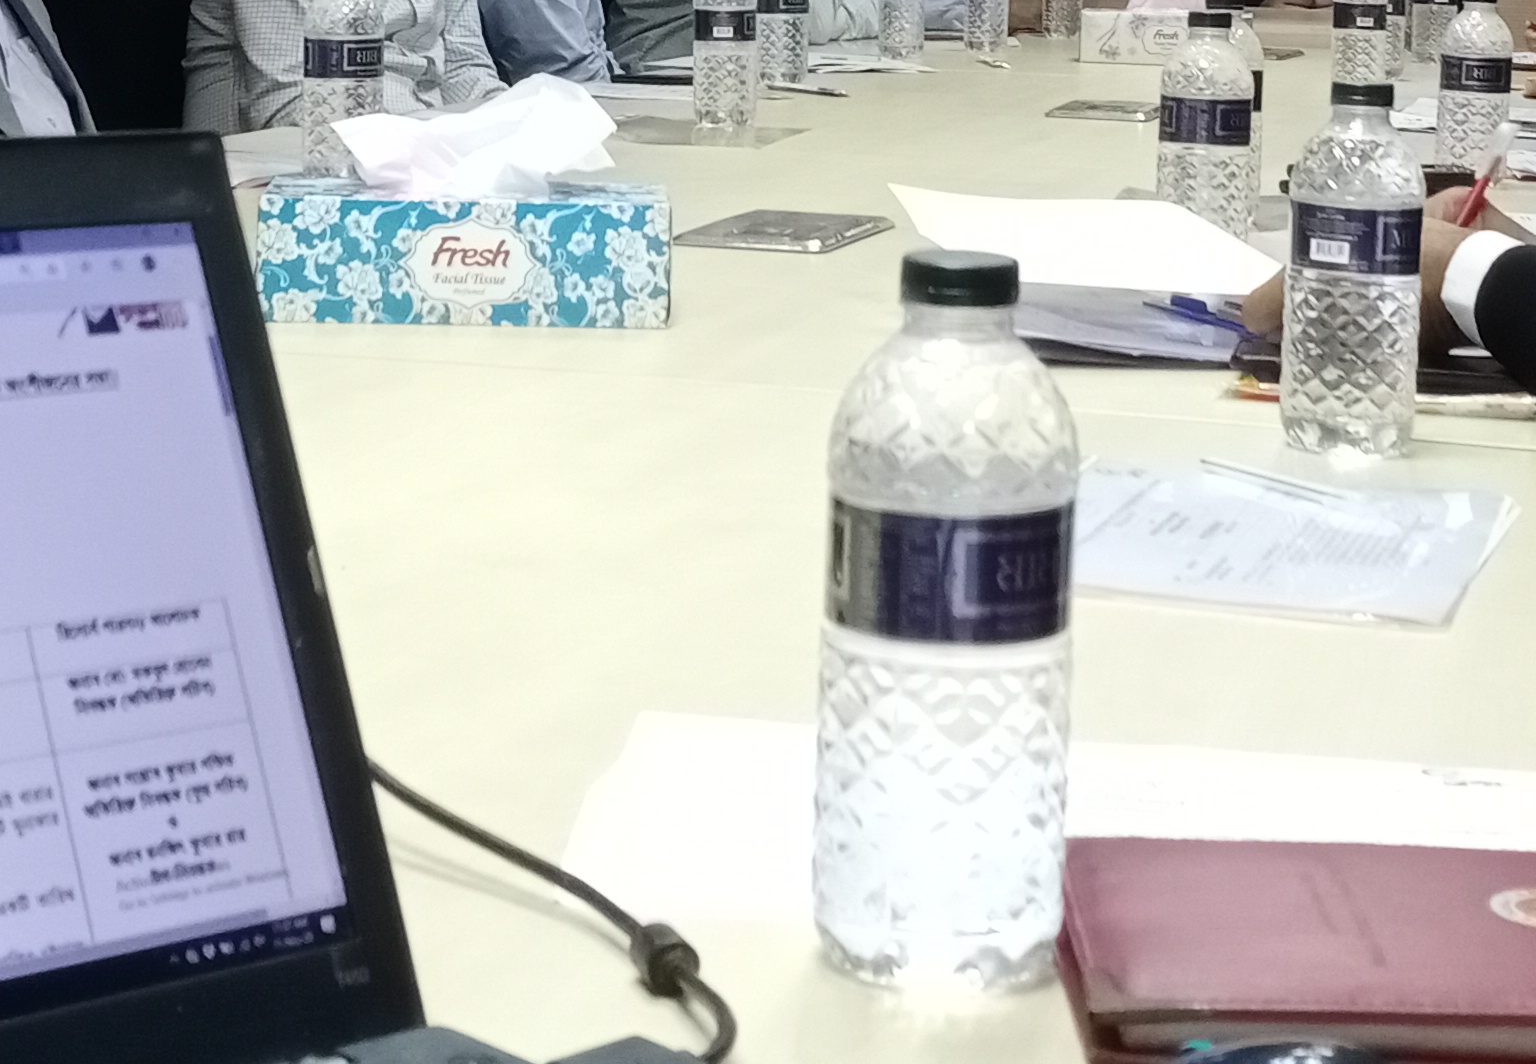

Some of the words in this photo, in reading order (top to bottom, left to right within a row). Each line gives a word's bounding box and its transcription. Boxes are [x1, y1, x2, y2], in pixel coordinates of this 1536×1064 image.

[1153, 29, 1179, 41] Fresh
[431, 236, 511, 268] Fresh
[433, 271, 468, 284] Facial
[470, 272, 506, 285] Tissue
